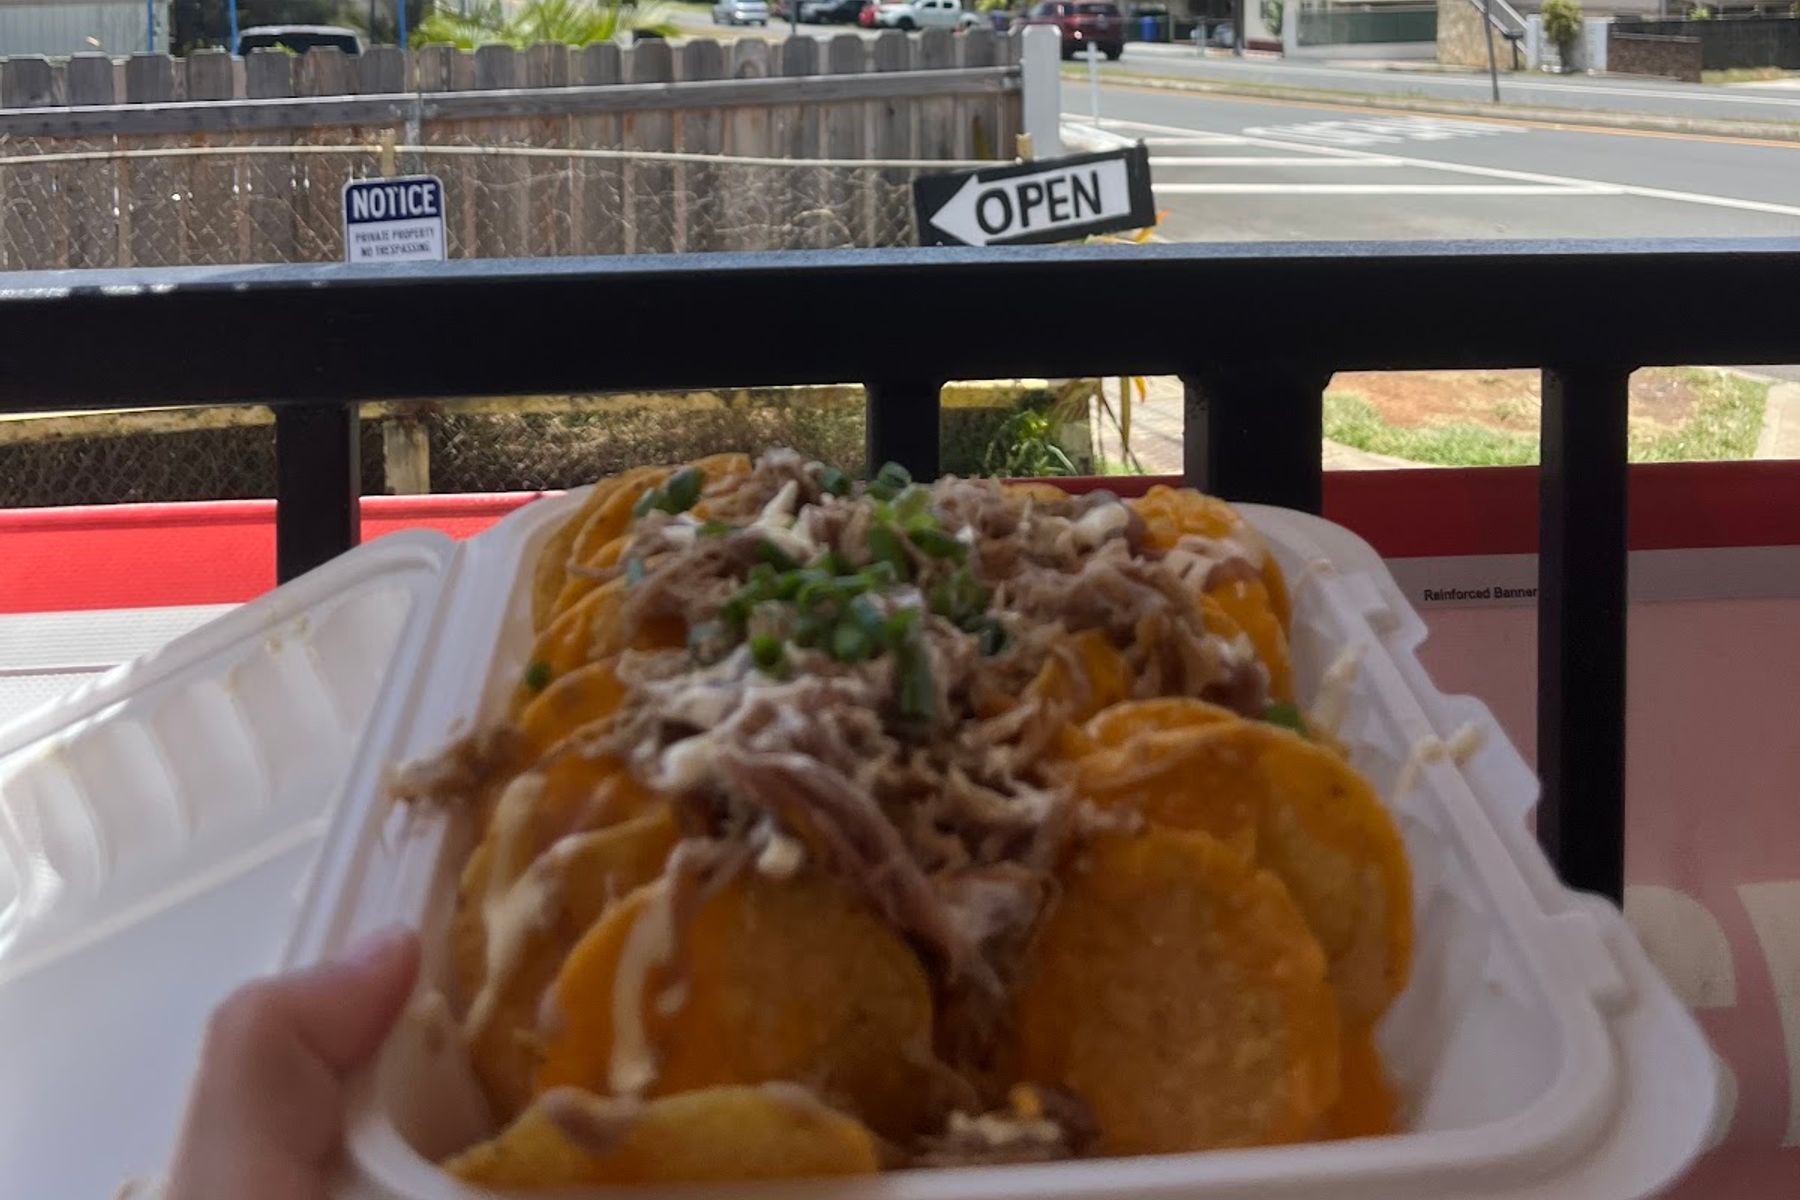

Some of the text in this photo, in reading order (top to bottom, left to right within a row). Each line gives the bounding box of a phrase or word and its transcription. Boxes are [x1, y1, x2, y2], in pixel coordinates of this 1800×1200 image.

[352, 183, 438, 220] NOTICE
[976, 170, 1102, 235] OPEN
[355, 226, 435, 243] PRIVATE PROPERTY
[361, 241, 431, 257] NO TRESPASSING
[1424, 586, 1538, 601] Reinforced Banner
